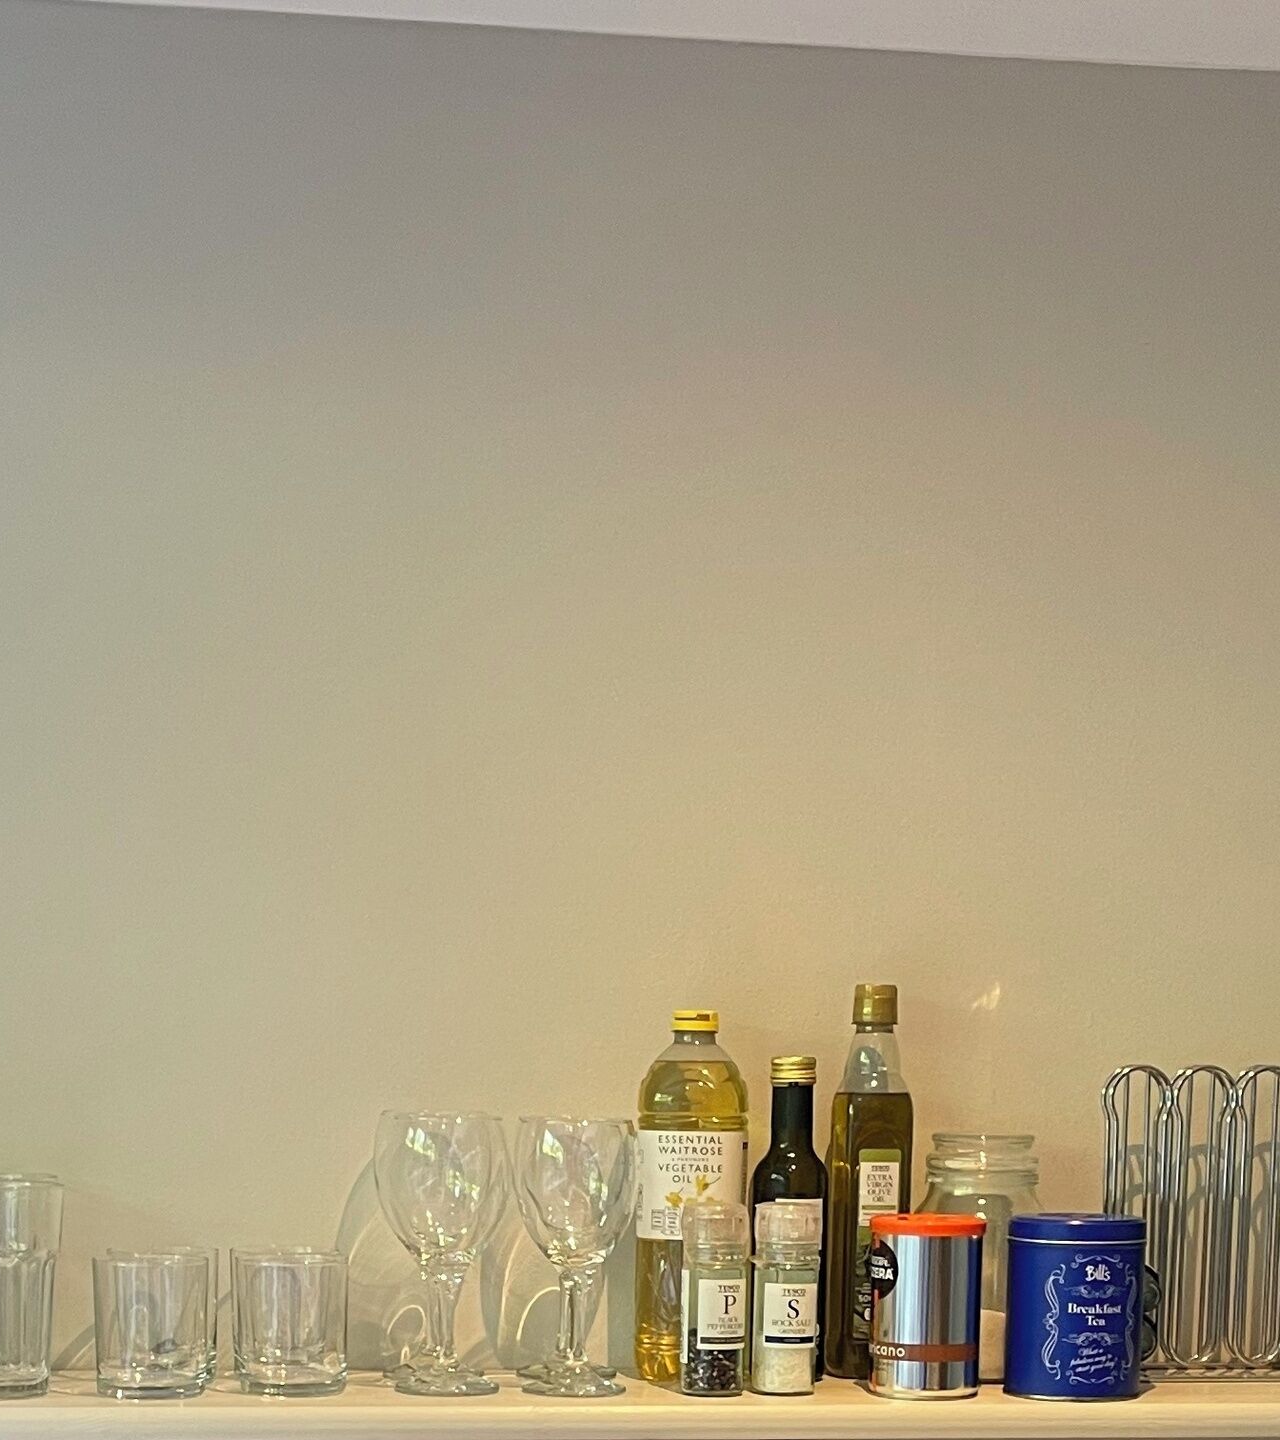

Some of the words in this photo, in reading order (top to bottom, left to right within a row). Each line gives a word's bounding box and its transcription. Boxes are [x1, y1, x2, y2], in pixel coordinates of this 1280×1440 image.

[658, 1135, 723, 1145] ESSENTIAL
[658, 1146, 723, 1156] WAITROSE
[658, 1163, 723, 1174] VEGETABLE
[672, 1174, 692, 1184] OIL
[866, 1174, 894, 1182] EXTRA
[1085, 1264, 1111, 1282] Bill's
[723, 1294, 737, 1315] P
[787, 1298, 800, 1320] S
[1067, 1302, 1122, 1315] Breakfast
[1086, 1315, 1106, 1327] Tea
